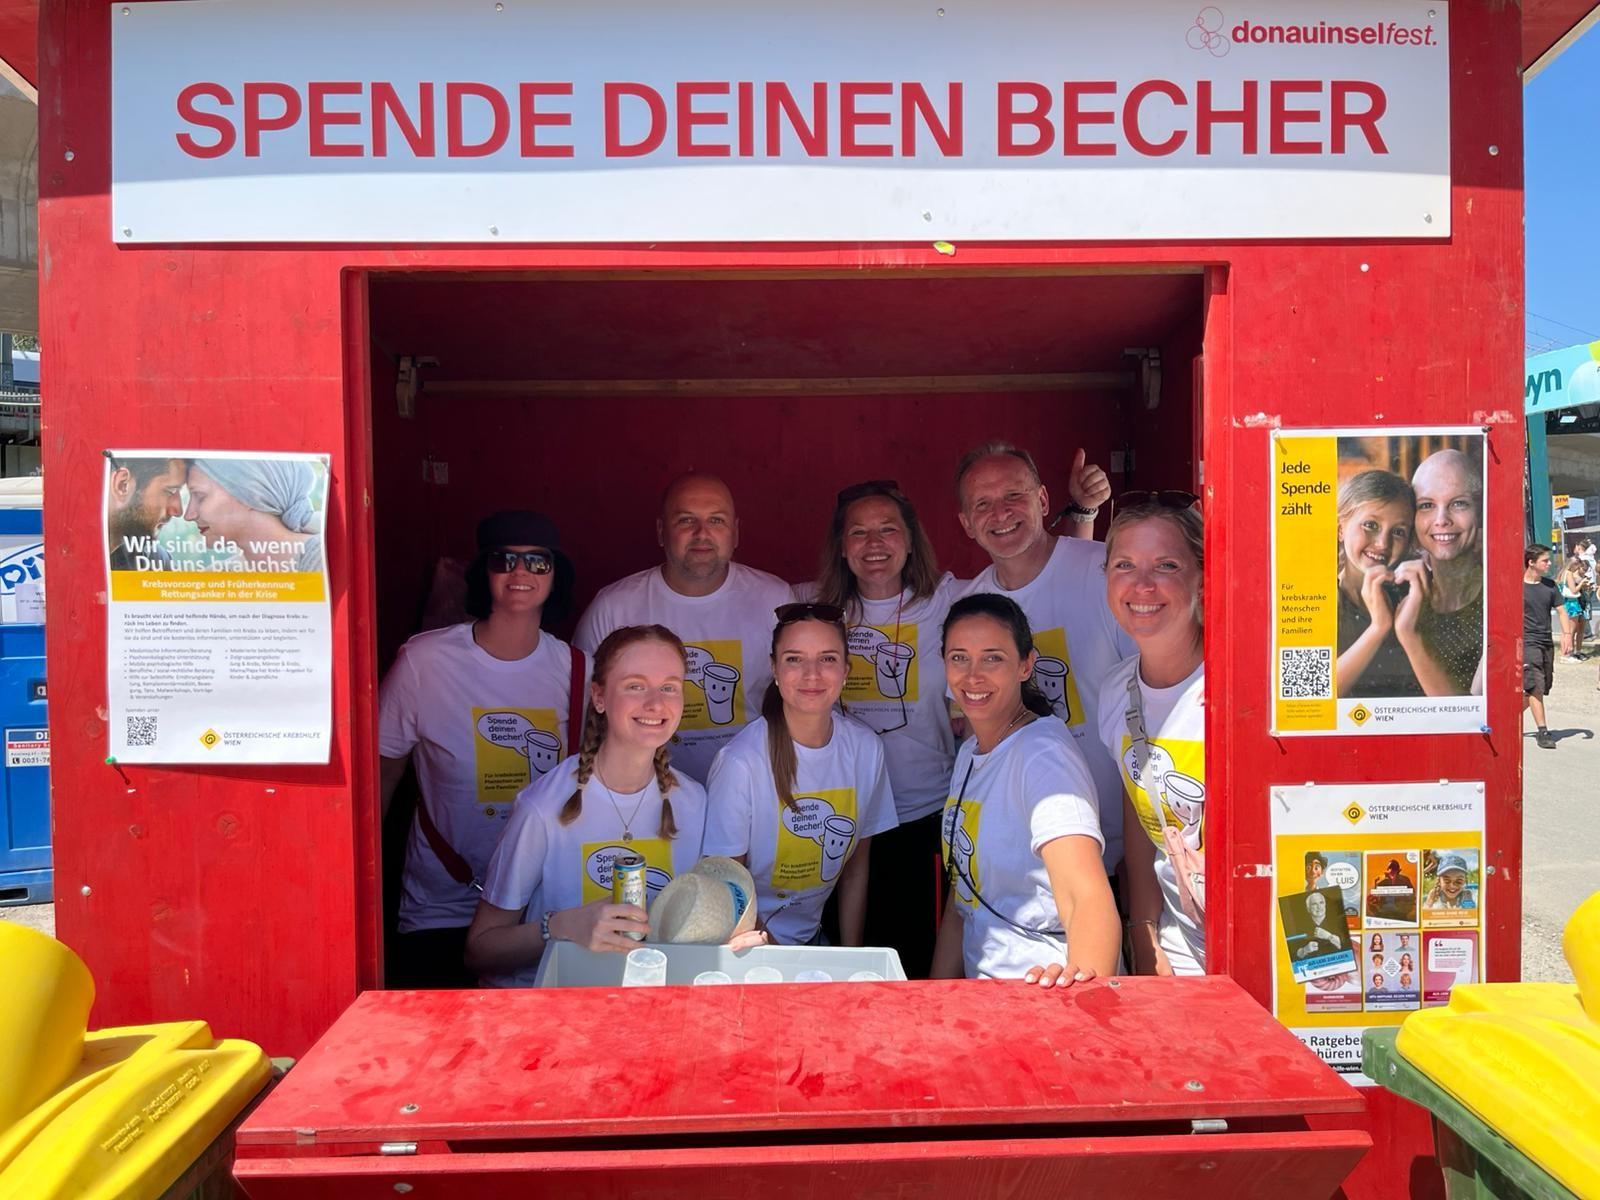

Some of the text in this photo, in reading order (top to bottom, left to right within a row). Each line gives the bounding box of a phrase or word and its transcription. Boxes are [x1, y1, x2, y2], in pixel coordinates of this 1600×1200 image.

[1231, 20, 1438, 46] donauinselfest.
[175, 79, 1389, 159] SPENDE DEINEN BECHER
[1281, 461, 1310, 474] Jede
[1281, 482, 1330, 496] Spende
[1281, 502, 1312, 515] zählt
[123, 536, 306, 556] Wir sind da, wenn
[136, 555, 298, 573] Du uns brauchst
[142, 580, 206, 590] Krebsvorsorge
[227, 580, 296, 590] Früherkennung
[161, 590, 225, 600] Rettungsanker
[256, 590, 278, 598] Krise
[487, 716, 517, 724] Spende
[792, 814, 817, 822] deinen
[794, 821, 822, 832] Becher!
[1310, 1035, 1362, 1048] Ratgebe
[1316, 1048, 1352, 1059] hüren
